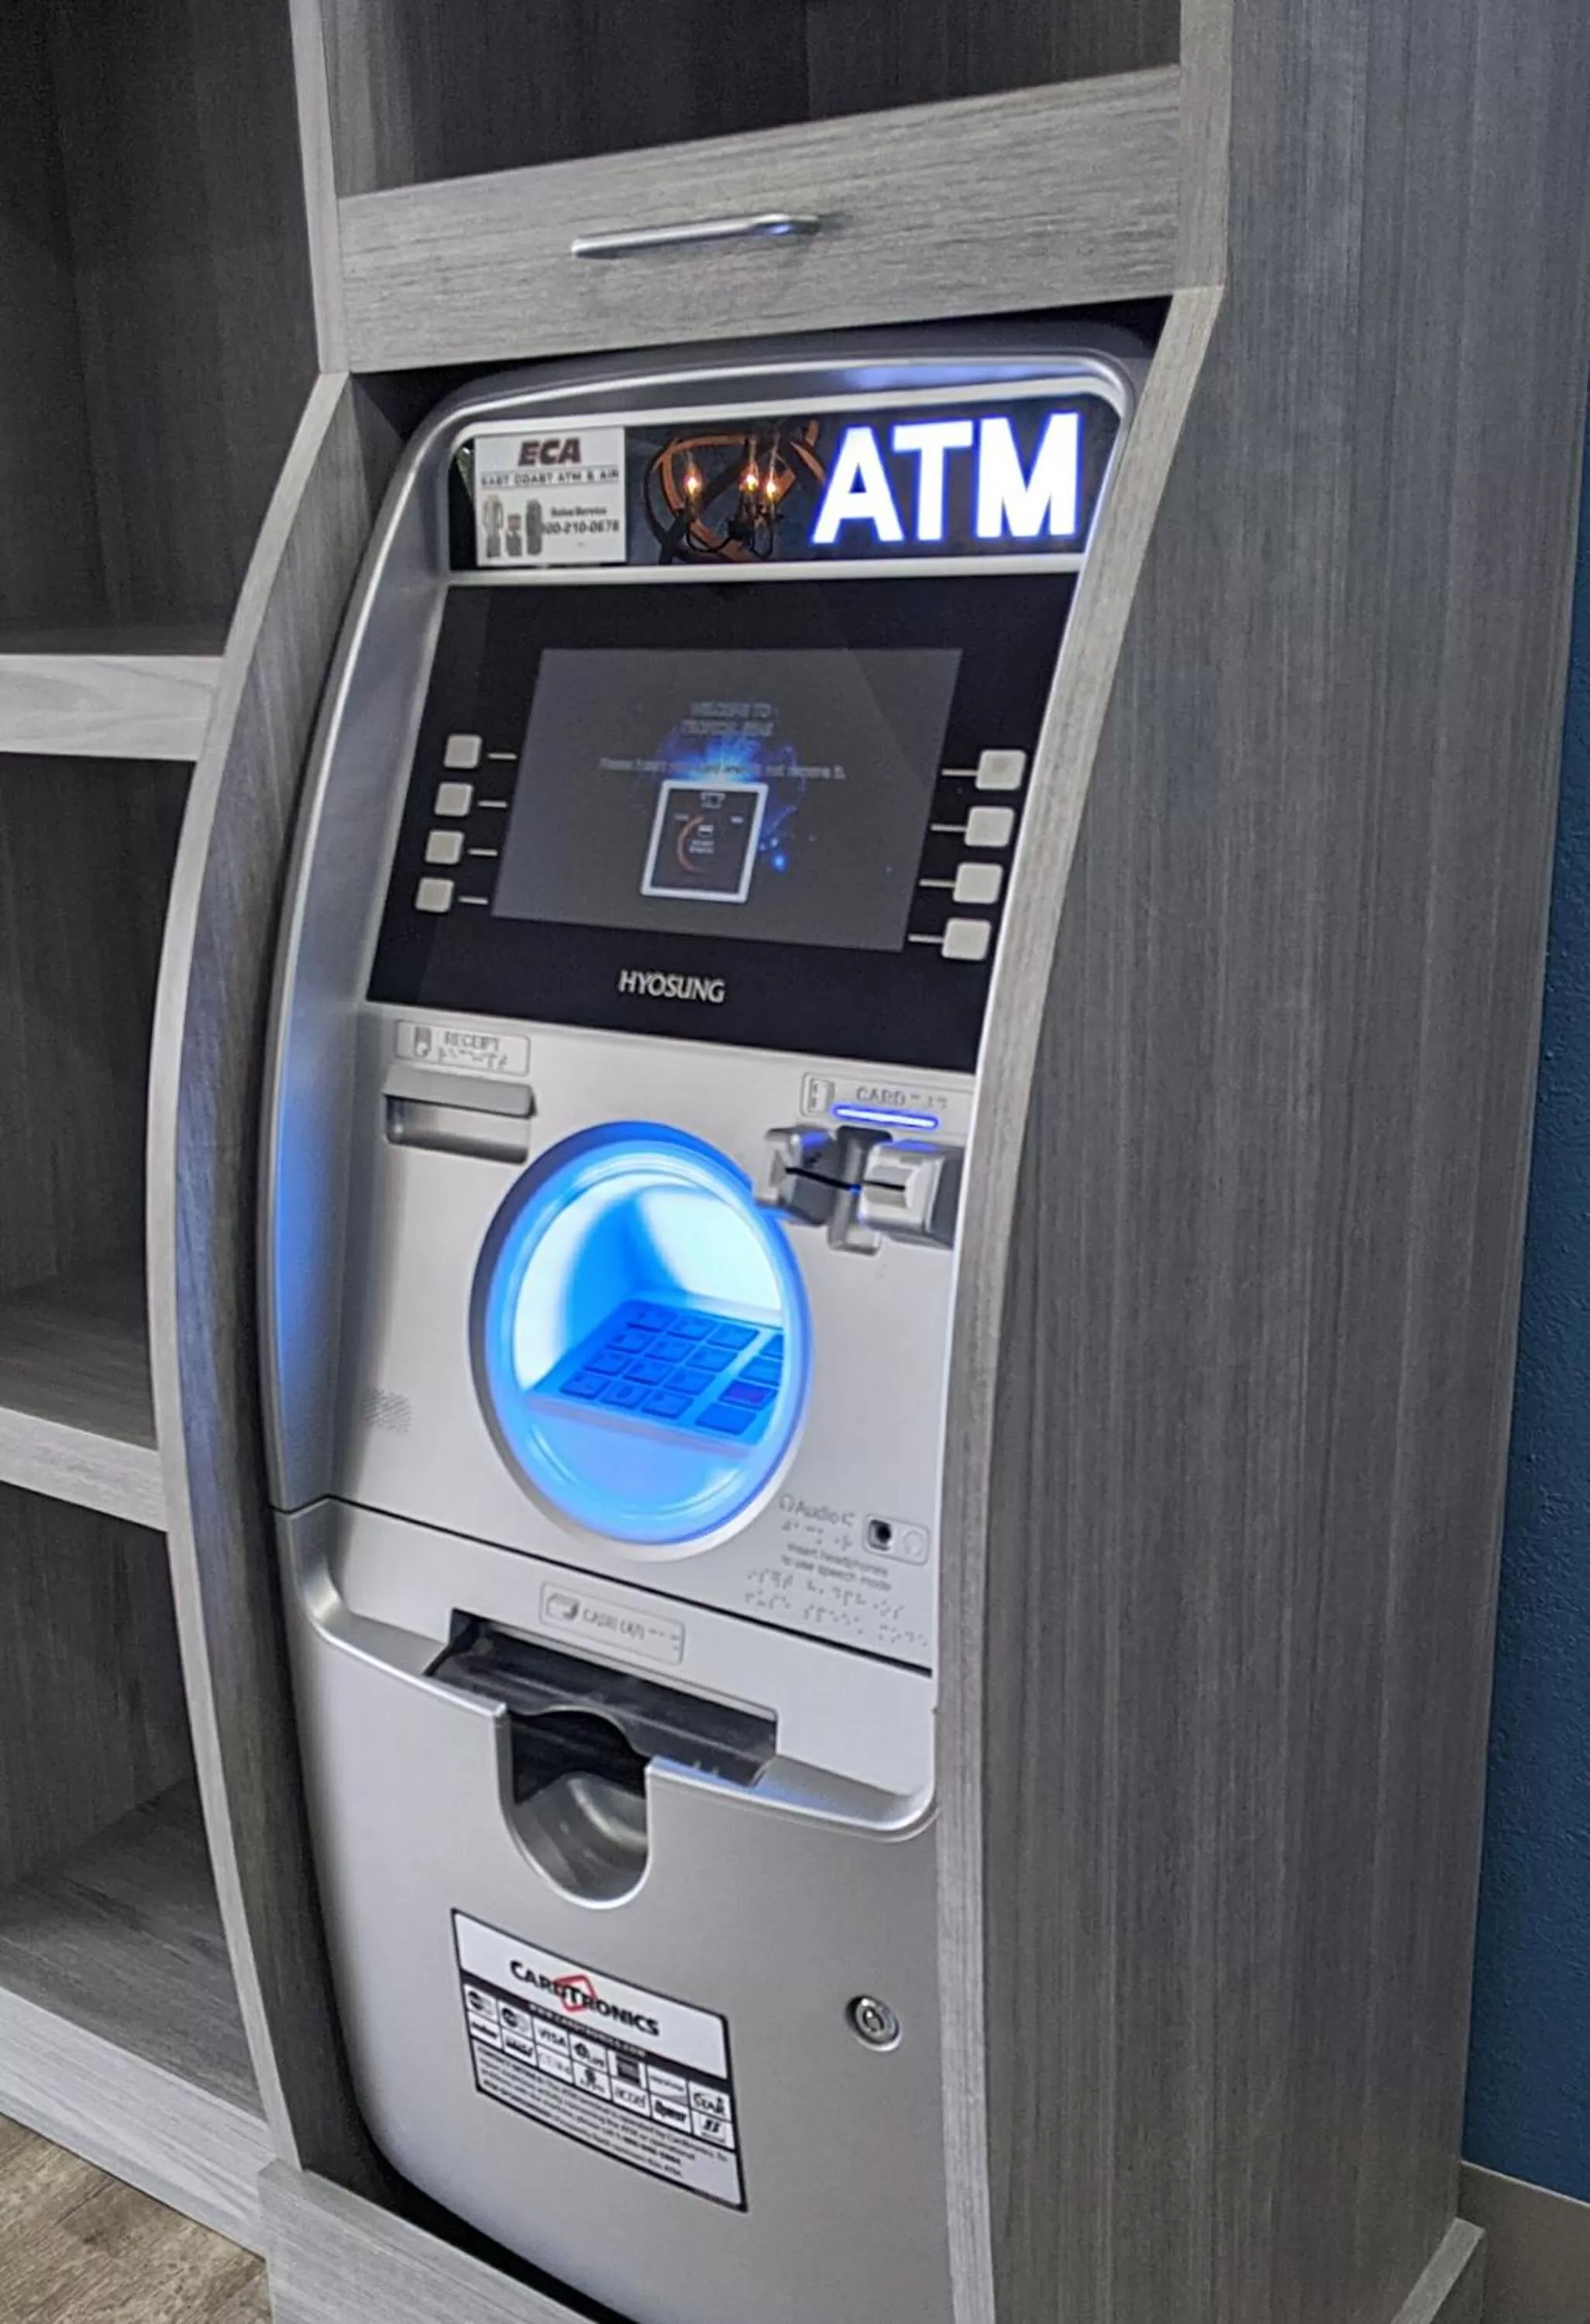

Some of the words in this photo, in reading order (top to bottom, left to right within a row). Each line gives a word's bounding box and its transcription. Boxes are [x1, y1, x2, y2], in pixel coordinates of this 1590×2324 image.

[518, 438, 581, 466] ECA
[480, 474, 508, 486] EAST
[515, 472, 552, 486] COAST
[558, 469, 581, 483] ATM
[599, 467, 619, 480] AIR
[811, 413, 1079, 544] ATM
[618, 969, 725, 1004] HYOSUNG
[444, 1030, 500, 1052] RECEIPT
[855, 1085, 906, 1106] CARD
[795, 1500, 838, 1525] Audio
[509, 1959, 661, 2037] CARDTRONICS
[538, 2024, 567, 2047] VISA
